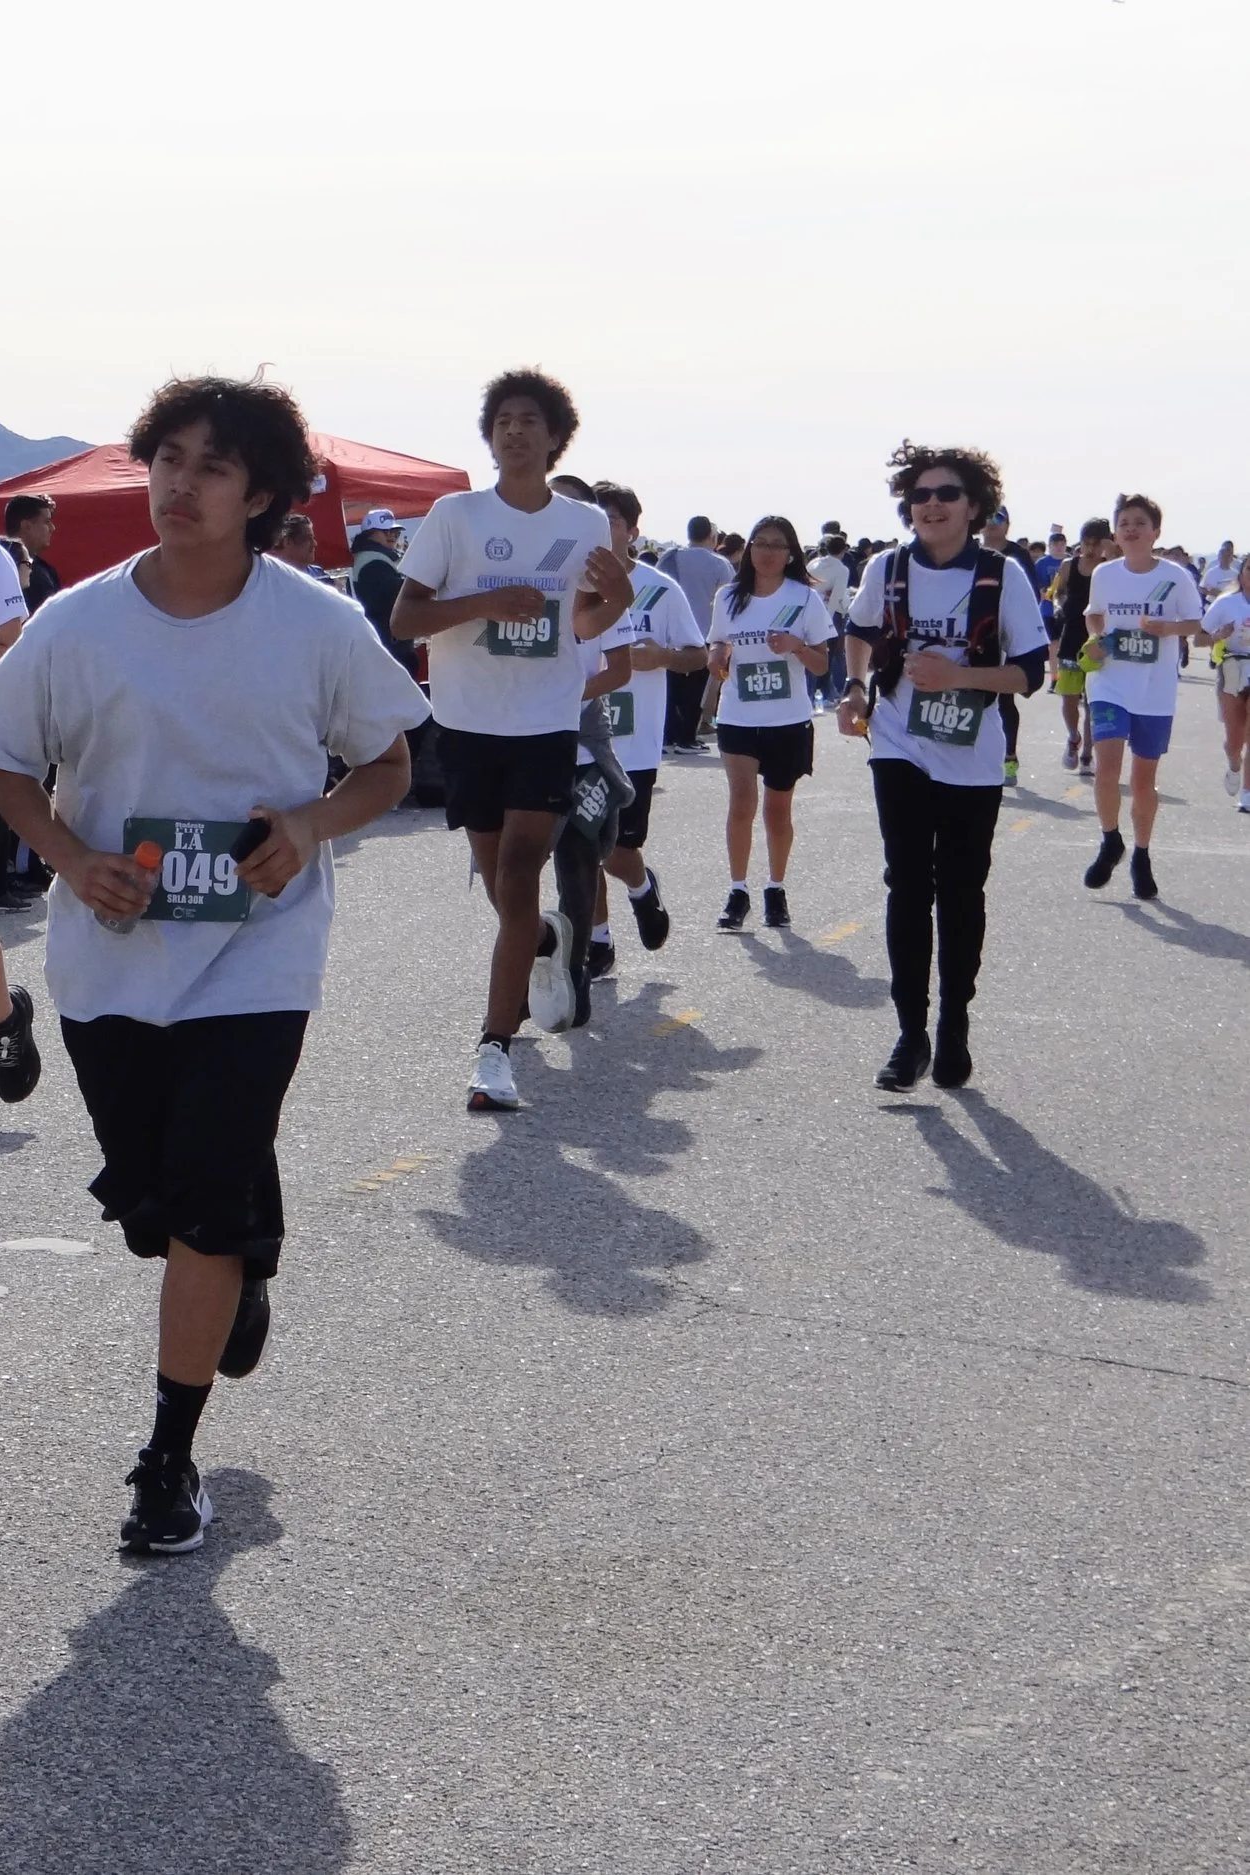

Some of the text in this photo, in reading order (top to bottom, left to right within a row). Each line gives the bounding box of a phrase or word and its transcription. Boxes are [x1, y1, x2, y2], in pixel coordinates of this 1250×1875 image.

[497, 617, 551, 642] 1069
[1118, 636, 1154, 655] 3013
[744, 672, 782, 692] 1375
[919, 700, 974, 732] 1082
[576, 776, 609, 822] 1897
[174, 832, 203, 851] LA
[166, 894, 204, 905] SRLA 30K
